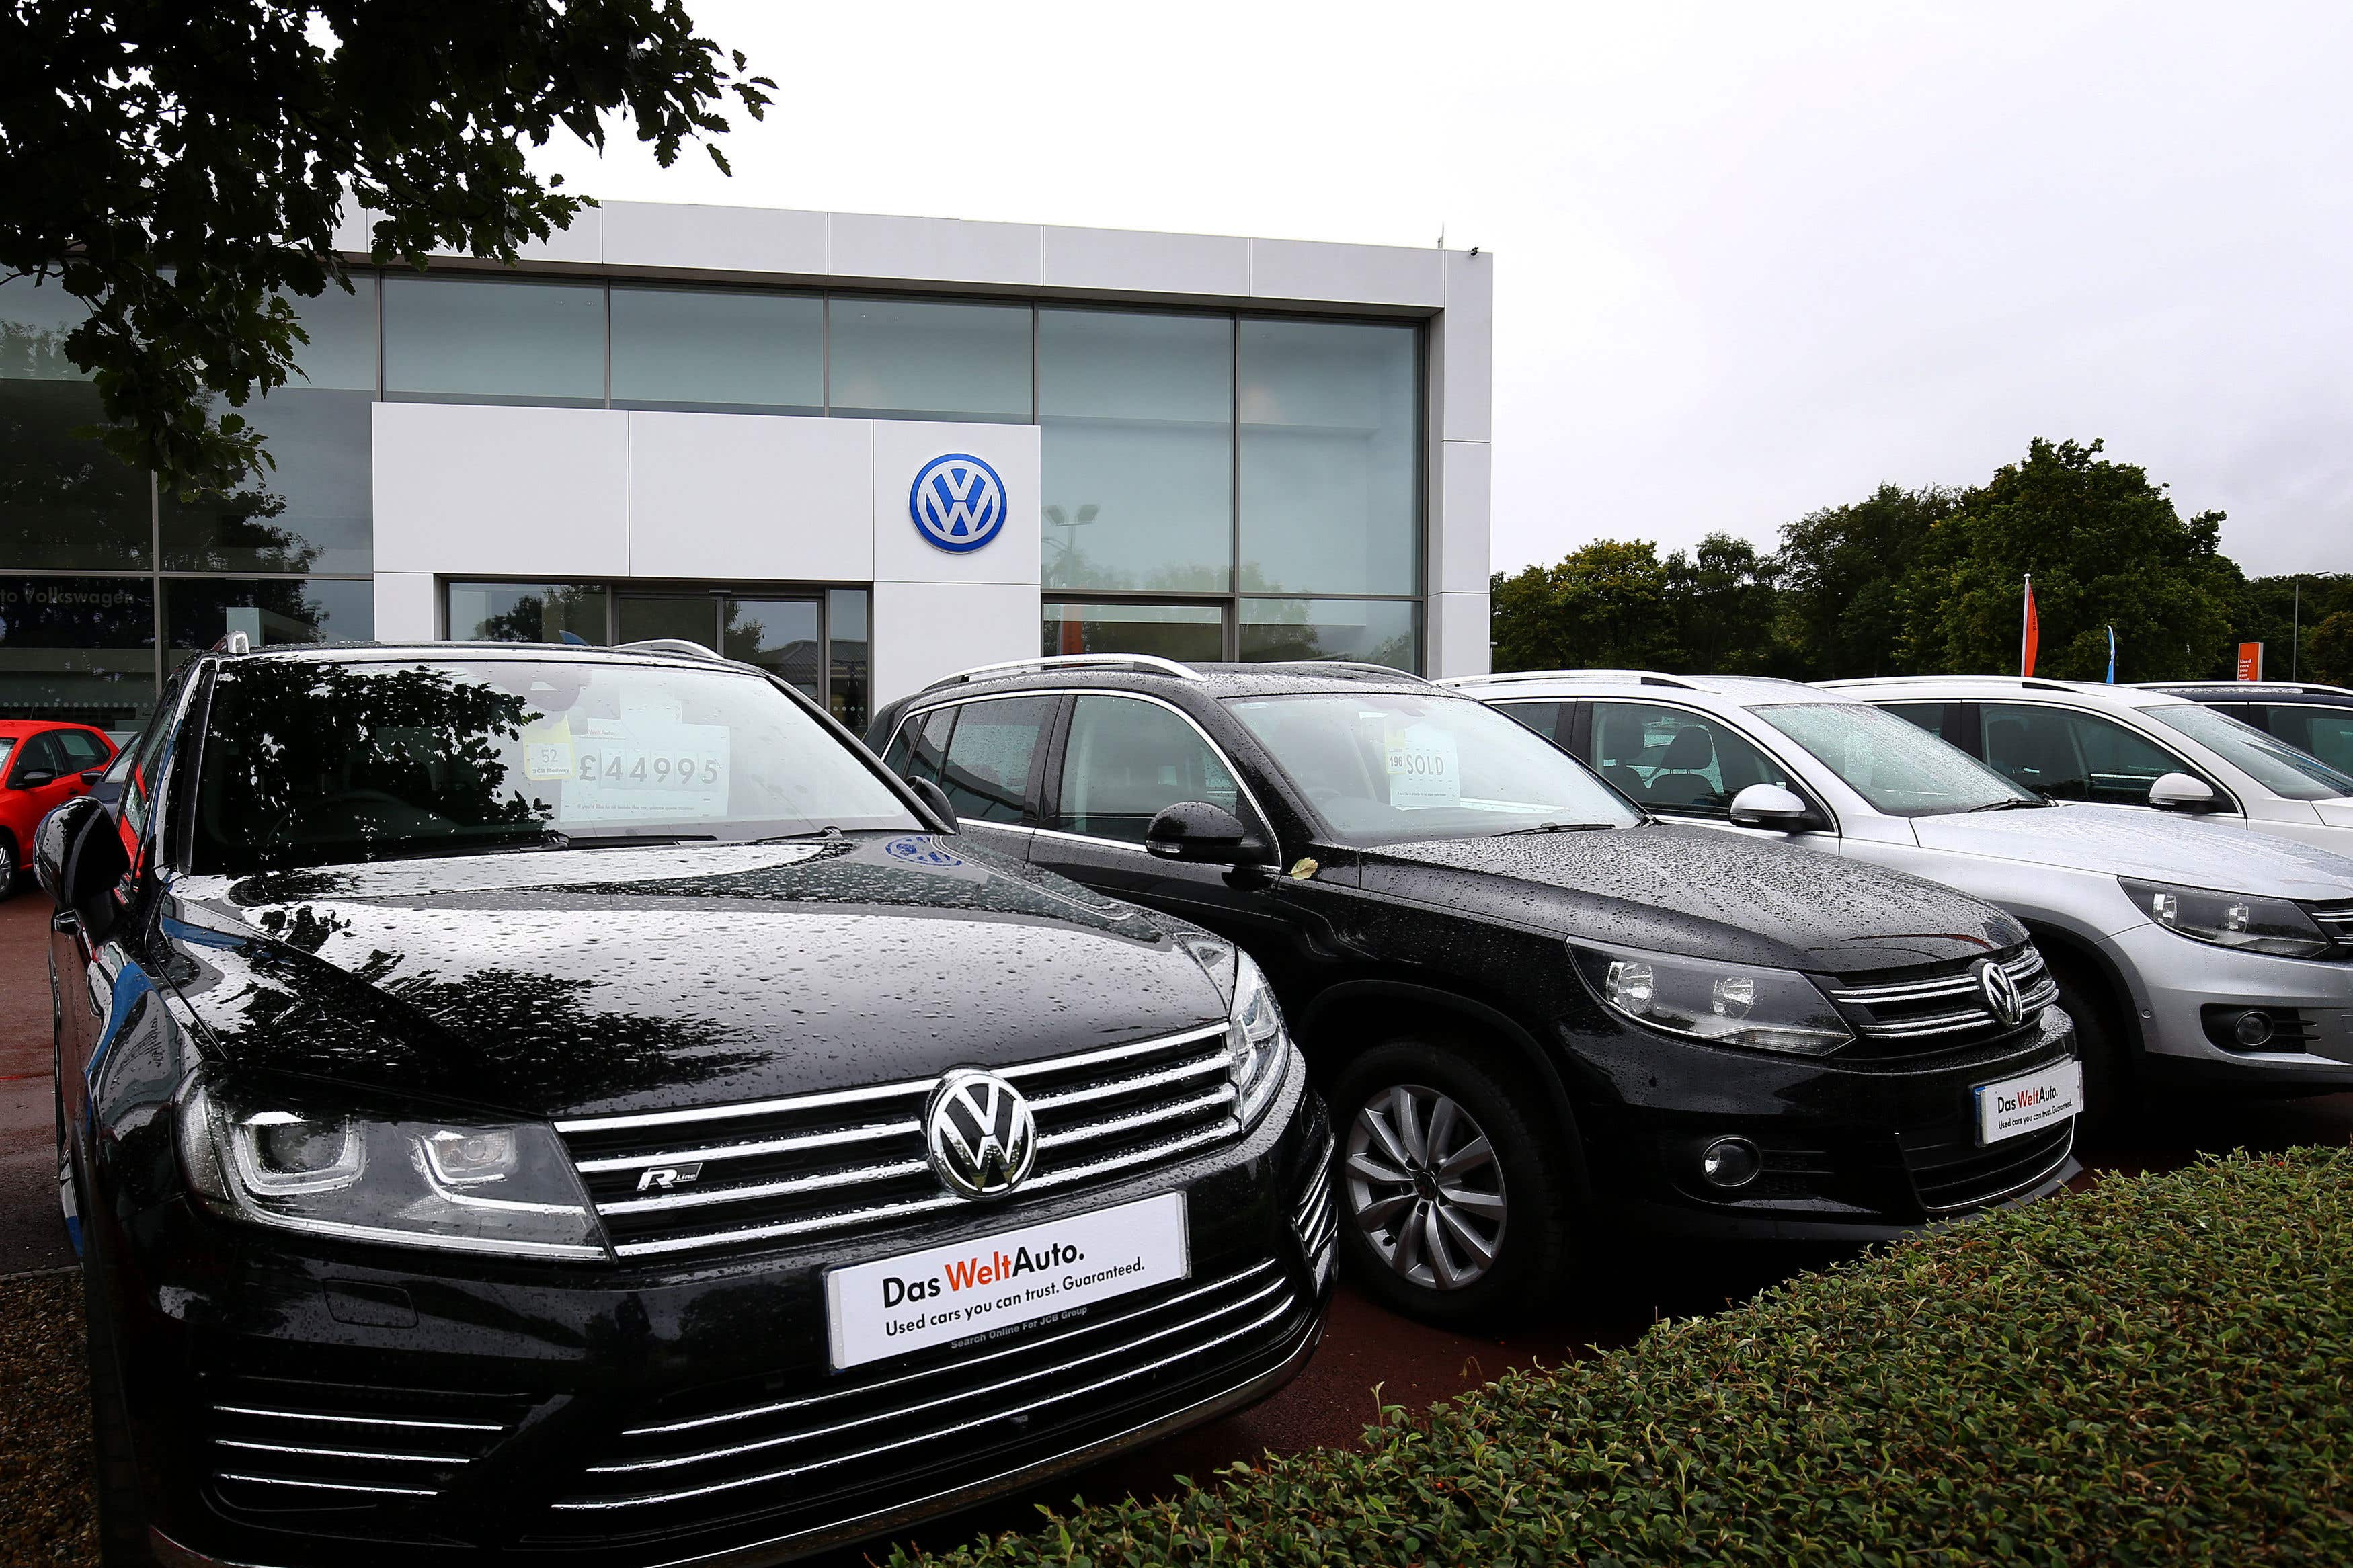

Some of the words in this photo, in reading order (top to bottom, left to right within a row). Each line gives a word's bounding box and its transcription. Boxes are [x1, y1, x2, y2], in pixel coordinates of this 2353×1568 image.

[23, 587, 134, 607] Volkswagen
[541, 749, 559, 763] 52
[579, 755, 718, 785] £44995
[1389, 756, 1403, 766] 196
[1406, 754, 1444, 776] SOLD
[1997, 1096, 2016, 1114] Das
[2017, 1086, 2058, 1108] WeltAuto.
[1999, 1118, 2011, 1129] Used
[2023, 1116, 2032, 1125] you
[2042, 1109, 2051, 1118] trust.
[2052, 1098, 2072, 1114] Guaranteed.
[883, 1277, 941, 1308] Das
[944, 1243, 1084, 1292] WeltAuto.
[885, 1313, 926, 1336] Used
[930, 1310, 961, 1325] cars
[964, 1302, 992, 1321] you
[996, 1294, 1021, 1309] can
[1025, 1282, 1060, 1301] trust.
[1062, 1256, 1145, 1290] Guaranteed.
[951, 1333, 986, 1349] Search
[989, 1325, 1020, 1339] Online
[1022, 1321, 1037, 1330] For
[1040, 1314, 1058, 1325] JCB
[1061, 1307, 1087, 1320] Group
